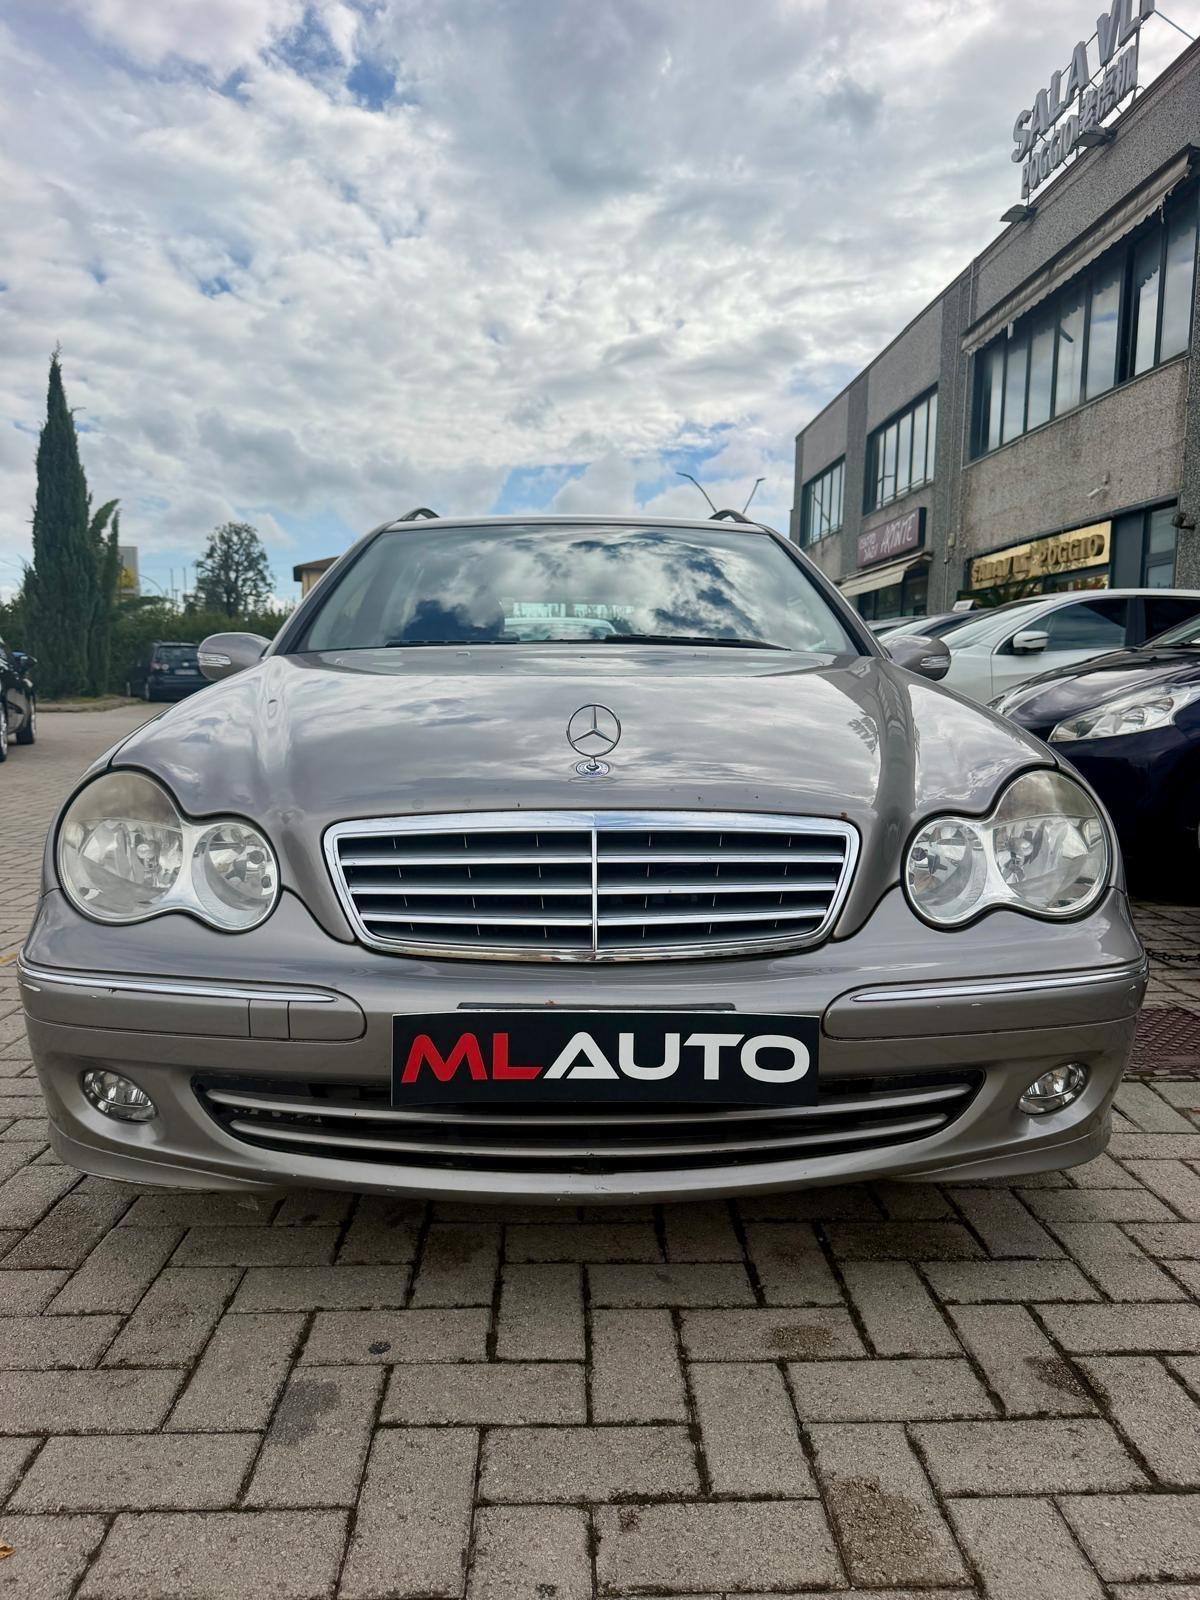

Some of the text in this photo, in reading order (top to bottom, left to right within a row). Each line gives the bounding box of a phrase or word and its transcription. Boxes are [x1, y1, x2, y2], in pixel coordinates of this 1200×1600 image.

[1011, 41, 1090, 163] SALA
[1021, 115, 1079, 199] POGGIO
[1039, 534, 1105, 565] POGGIO
